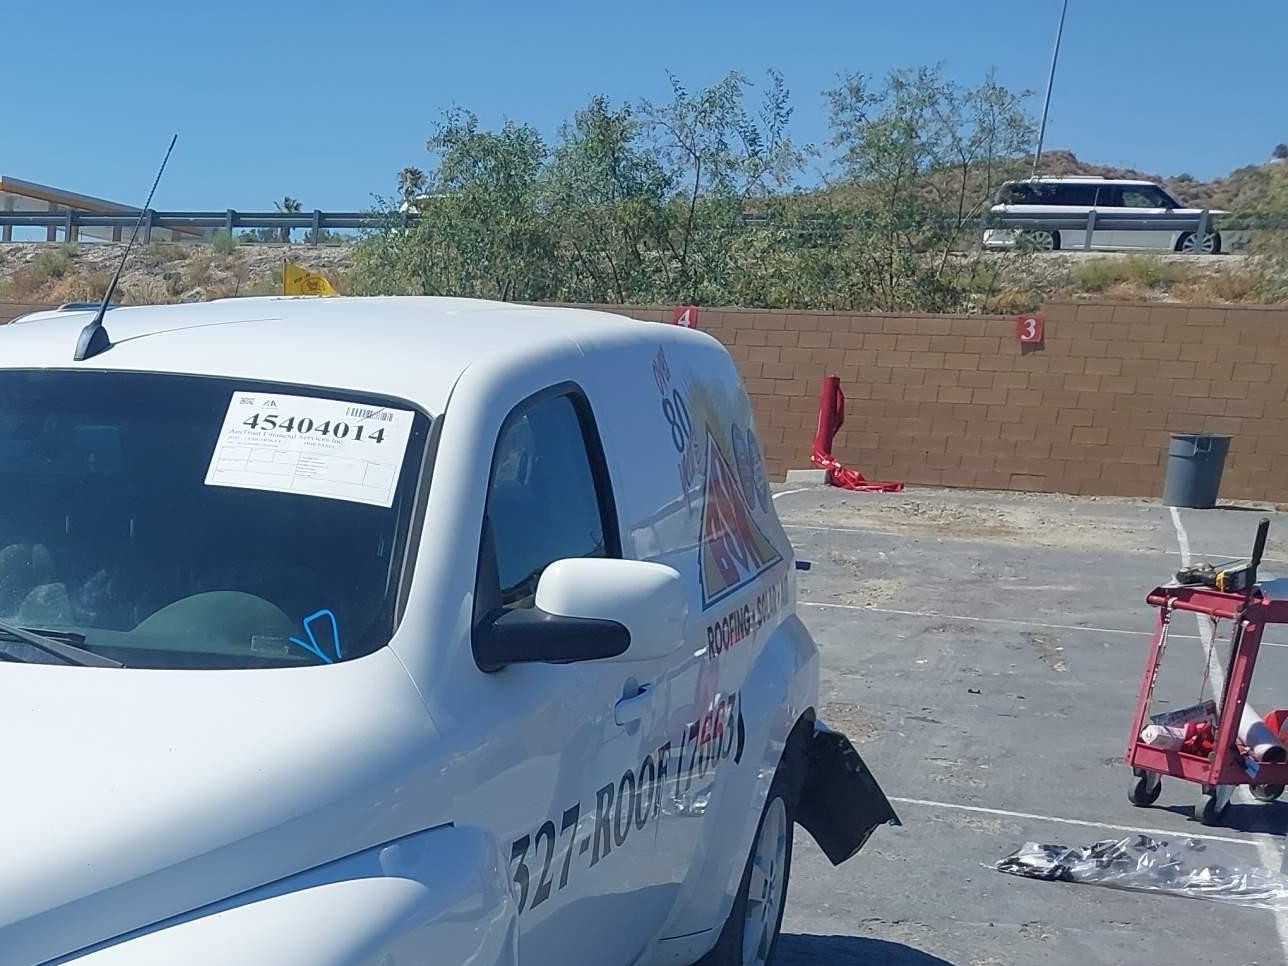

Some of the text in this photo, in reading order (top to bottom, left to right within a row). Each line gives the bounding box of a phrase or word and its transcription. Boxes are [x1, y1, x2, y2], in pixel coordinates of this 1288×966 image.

[677, 309, 691, 328] 4
[1020, 318, 1037, 340] 3
[242, 412, 386, 444] 45404014
[661, 388, 692, 454] 80
[706, 606, 751, 662] ROOFING
[510, 741, 672, 915] 327-ROOF
